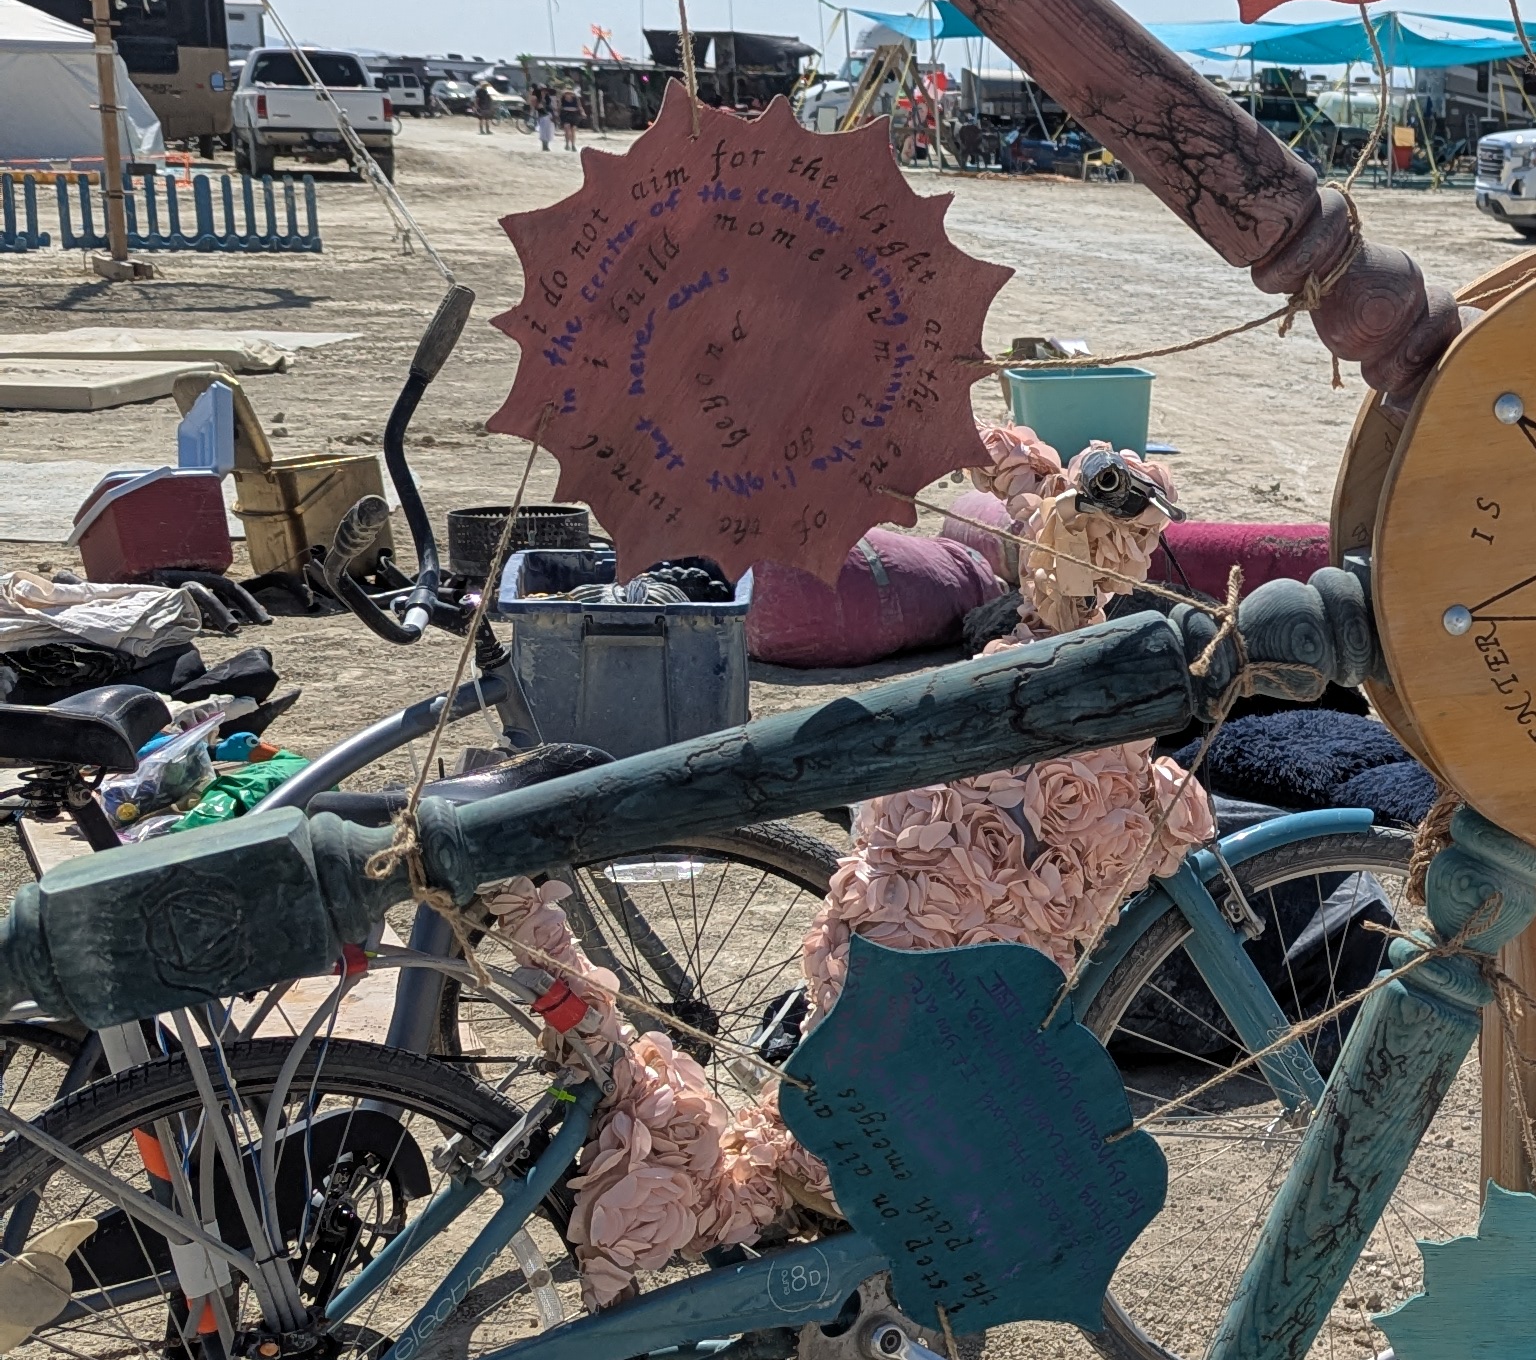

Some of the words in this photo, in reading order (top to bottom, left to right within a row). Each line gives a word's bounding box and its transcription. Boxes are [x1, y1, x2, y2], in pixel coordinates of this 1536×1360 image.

[710, 140, 765, 180] for
[788, 154, 839, 190] the
[631, 165, 691, 200] aim
[697, 180, 742, 204] the
[650, 189, 680, 218] of
[757, 188, 845, 236] center
[572, 207, 608, 259] not
[859, 203, 937, 284] light
[581, 219, 639, 303] center
[609, 228, 681, 325] build
[544, 268, 569, 309] do
[666, 267, 730, 311] ends
[713, 212, 891, 363] momentum
[525, 314, 549, 335] i
[543, 316, 583, 367] the
[925, 319, 942, 351] at
[585, 356, 609, 369] i
[629, 308, 656, 396] never
[695, 310, 750, 448] beyond
[907, 369, 941, 413] the
[555, 388, 576, 413] in
[842, 393, 876, 423] to
[634, 416, 685, 471] that
[784, 427, 814, 461] go
[810, 438, 863, 471] the
[571, 433, 683, 524] tunnel
[706, 468, 797, 499] light
[858, 439, 902, 491] end
[719, 515, 763, 546] the
[799, 510, 828, 547] of
[1470, 496, 1501, 546] IS
[838, 1089, 912, 1180] emerges
[834, 1140, 873, 1176] air
[872, 1194, 899, 1218] on
[907, 1197, 972, 1251] path
[905, 1239, 948, 1290] step
[963, 1272, 998, 1306] the
